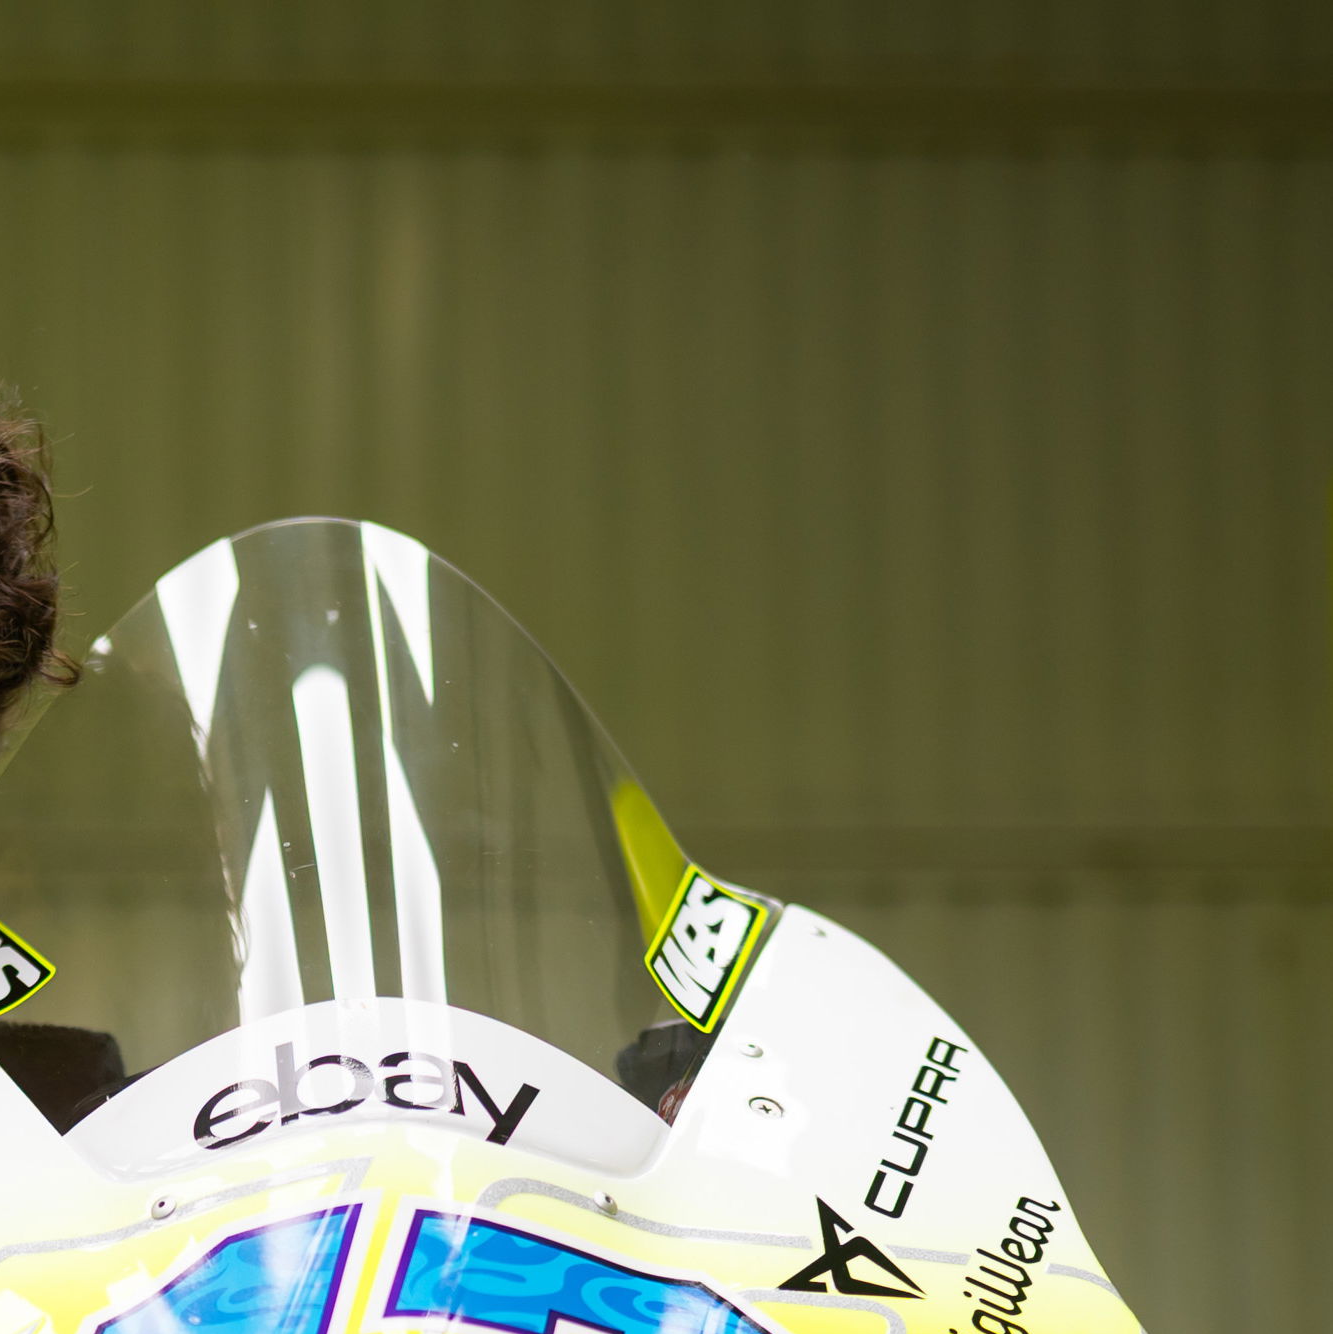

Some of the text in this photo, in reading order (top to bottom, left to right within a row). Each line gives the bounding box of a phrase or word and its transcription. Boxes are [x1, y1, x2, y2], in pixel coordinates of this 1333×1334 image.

[652, 876, 753, 1020] WRS
[193, 1042, 541, 1150] ebay
[864, 1036, 969, 1219] CUPRA
